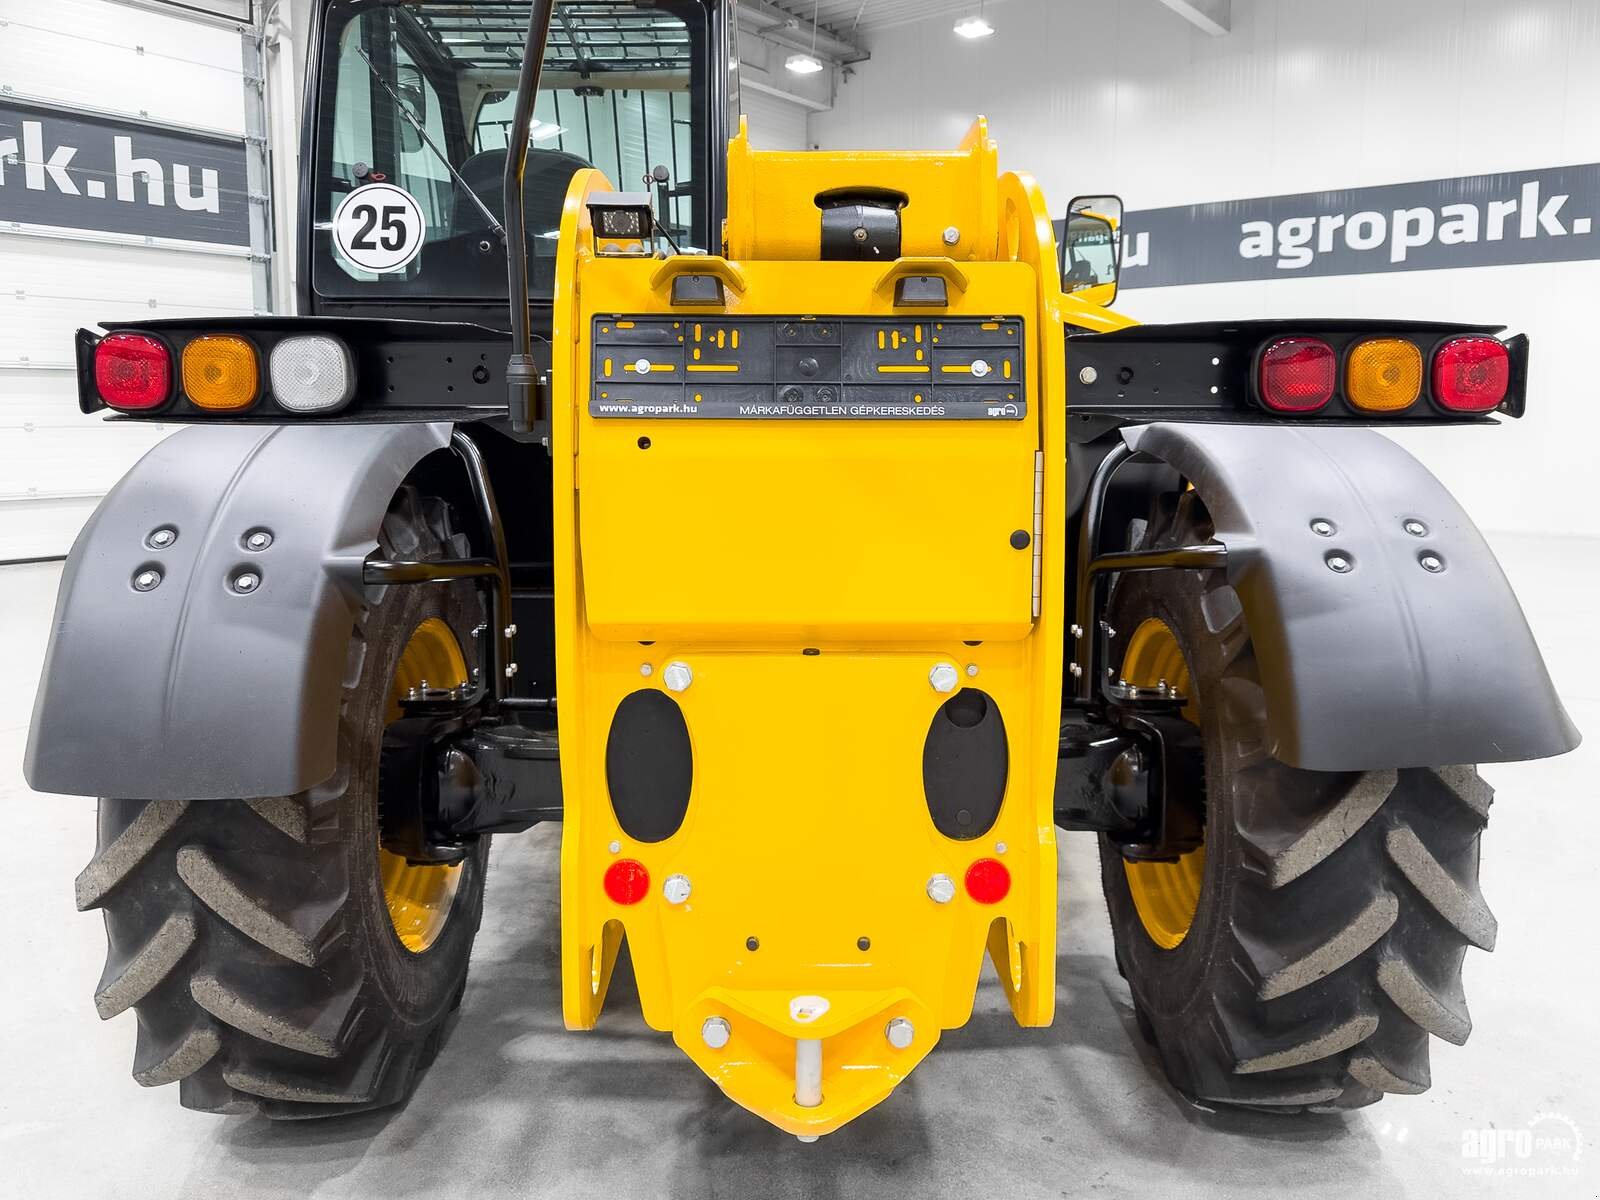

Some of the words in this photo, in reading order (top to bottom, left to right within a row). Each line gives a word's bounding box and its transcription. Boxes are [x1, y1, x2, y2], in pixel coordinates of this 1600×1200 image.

[350, 204, 407, 252] 25
[1239, 181, 1592, 270] agropark.
[599, 403, 698, 415] www.agropark.hu
[739, 404, 848, 416] MÁRKAFÜGGETLEN
[850, 404, 946, 416] GÉPKERESKEDÉS
